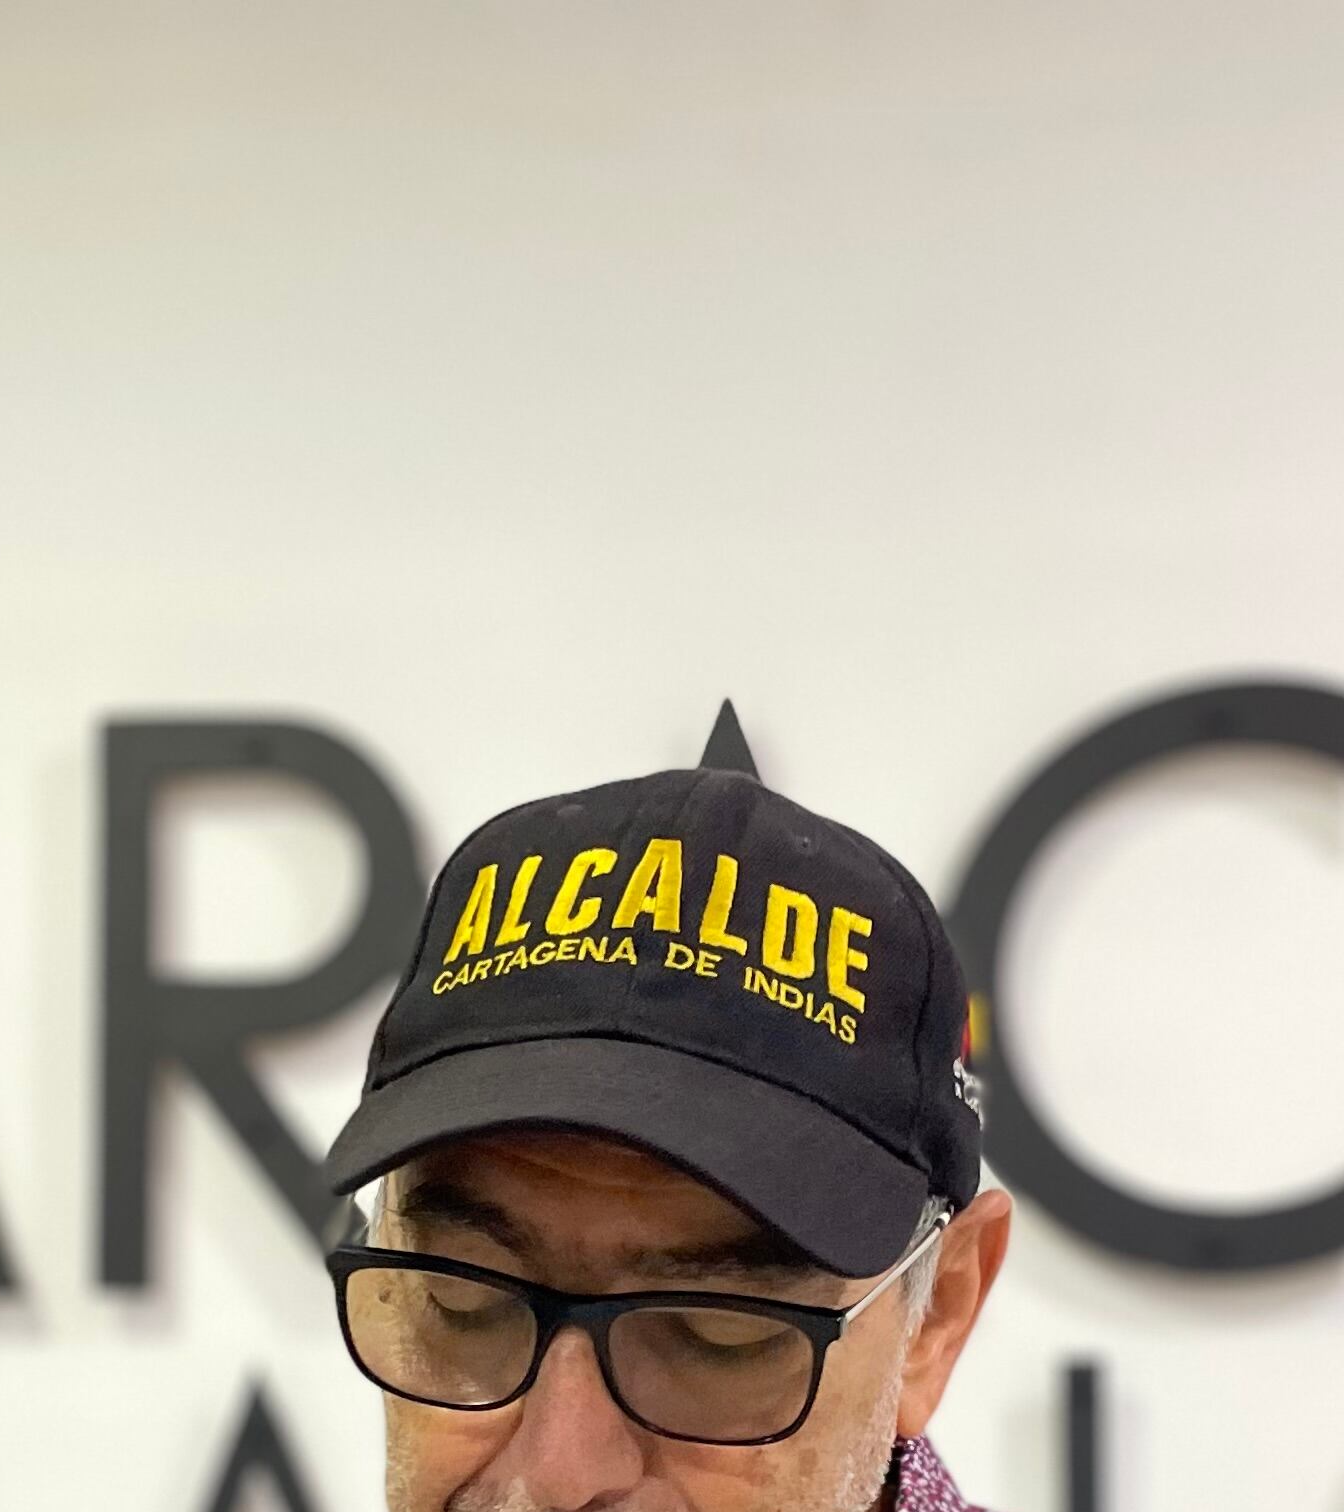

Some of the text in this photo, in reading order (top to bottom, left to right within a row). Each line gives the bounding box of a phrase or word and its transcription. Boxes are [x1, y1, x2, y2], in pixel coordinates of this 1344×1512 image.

[432, 936, 858, 1045] CARTAGENA DE INDIAS
[442, 838, 873, 1013] ALCALDE
